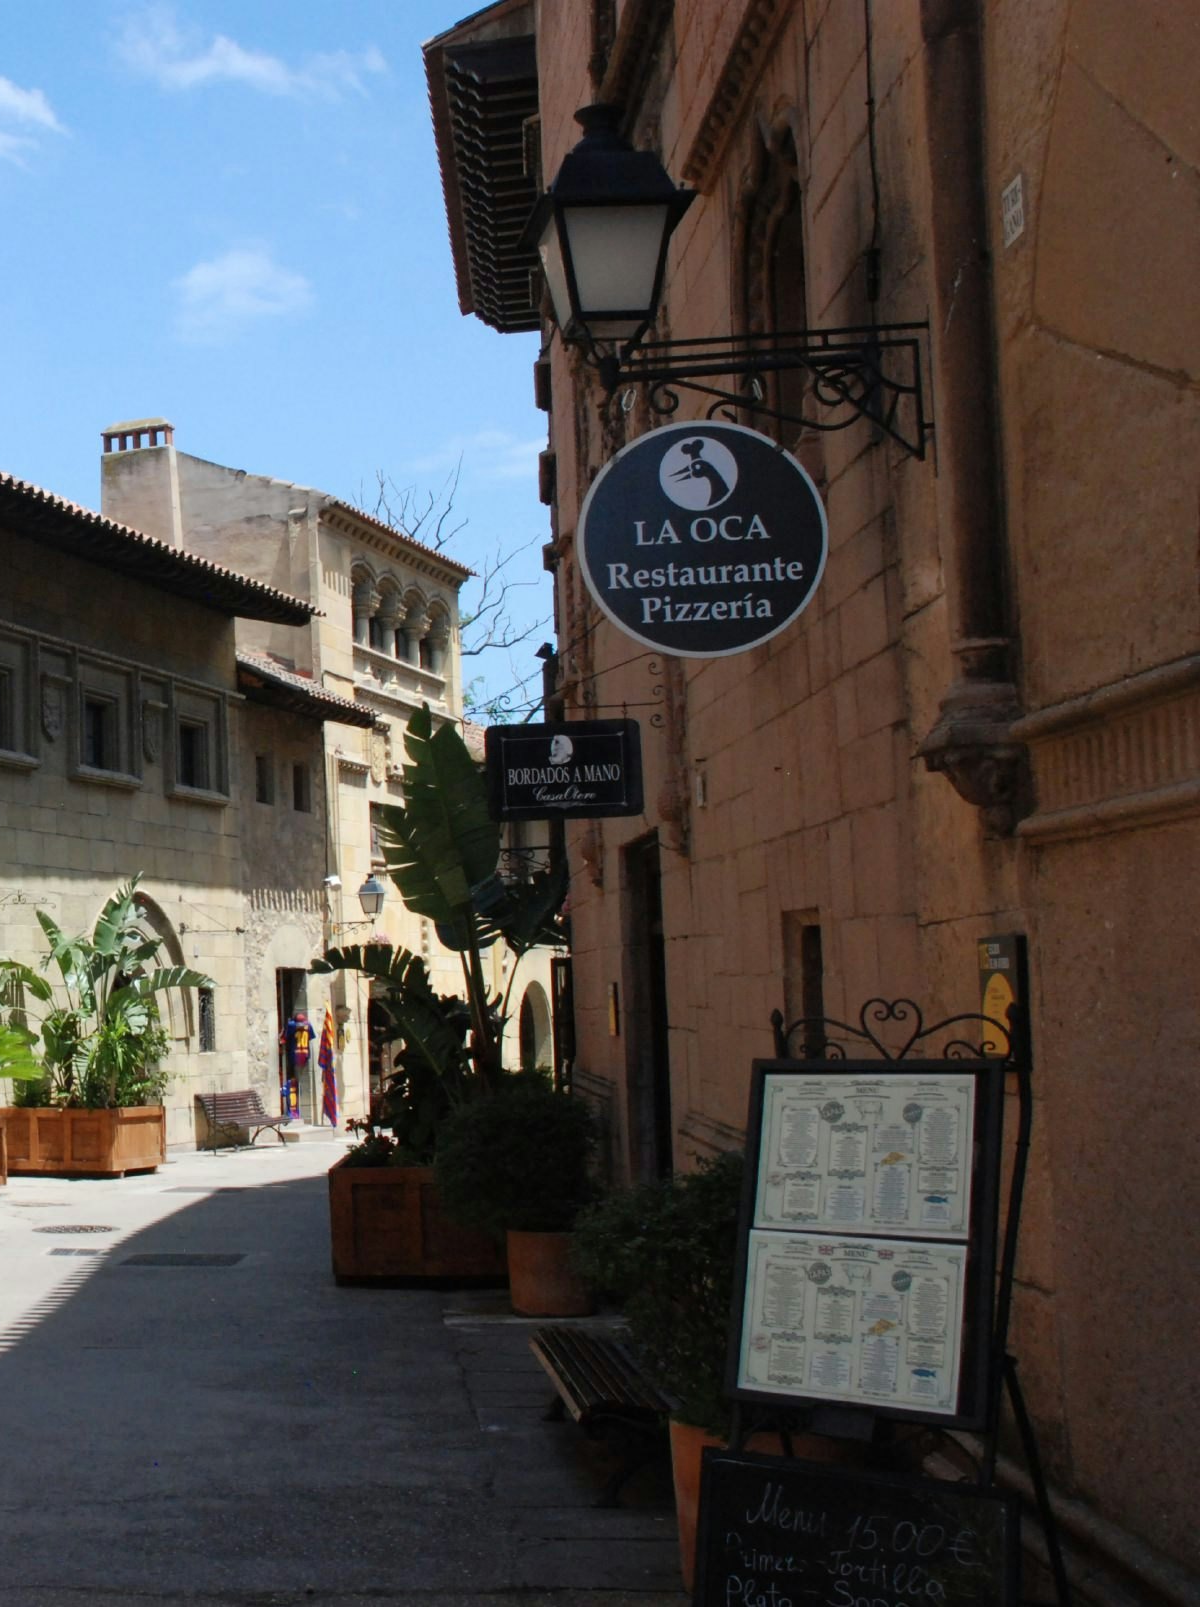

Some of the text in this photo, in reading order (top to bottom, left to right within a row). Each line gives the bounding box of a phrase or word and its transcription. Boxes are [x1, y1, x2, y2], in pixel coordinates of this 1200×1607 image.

[633, 514, 772, 546] LA OCA
[606, 556, 804, 590] Restaurante
[640, 592, 774, 624] Pizzería
[508, 763, 621, 786] BORDADOS A MANO
